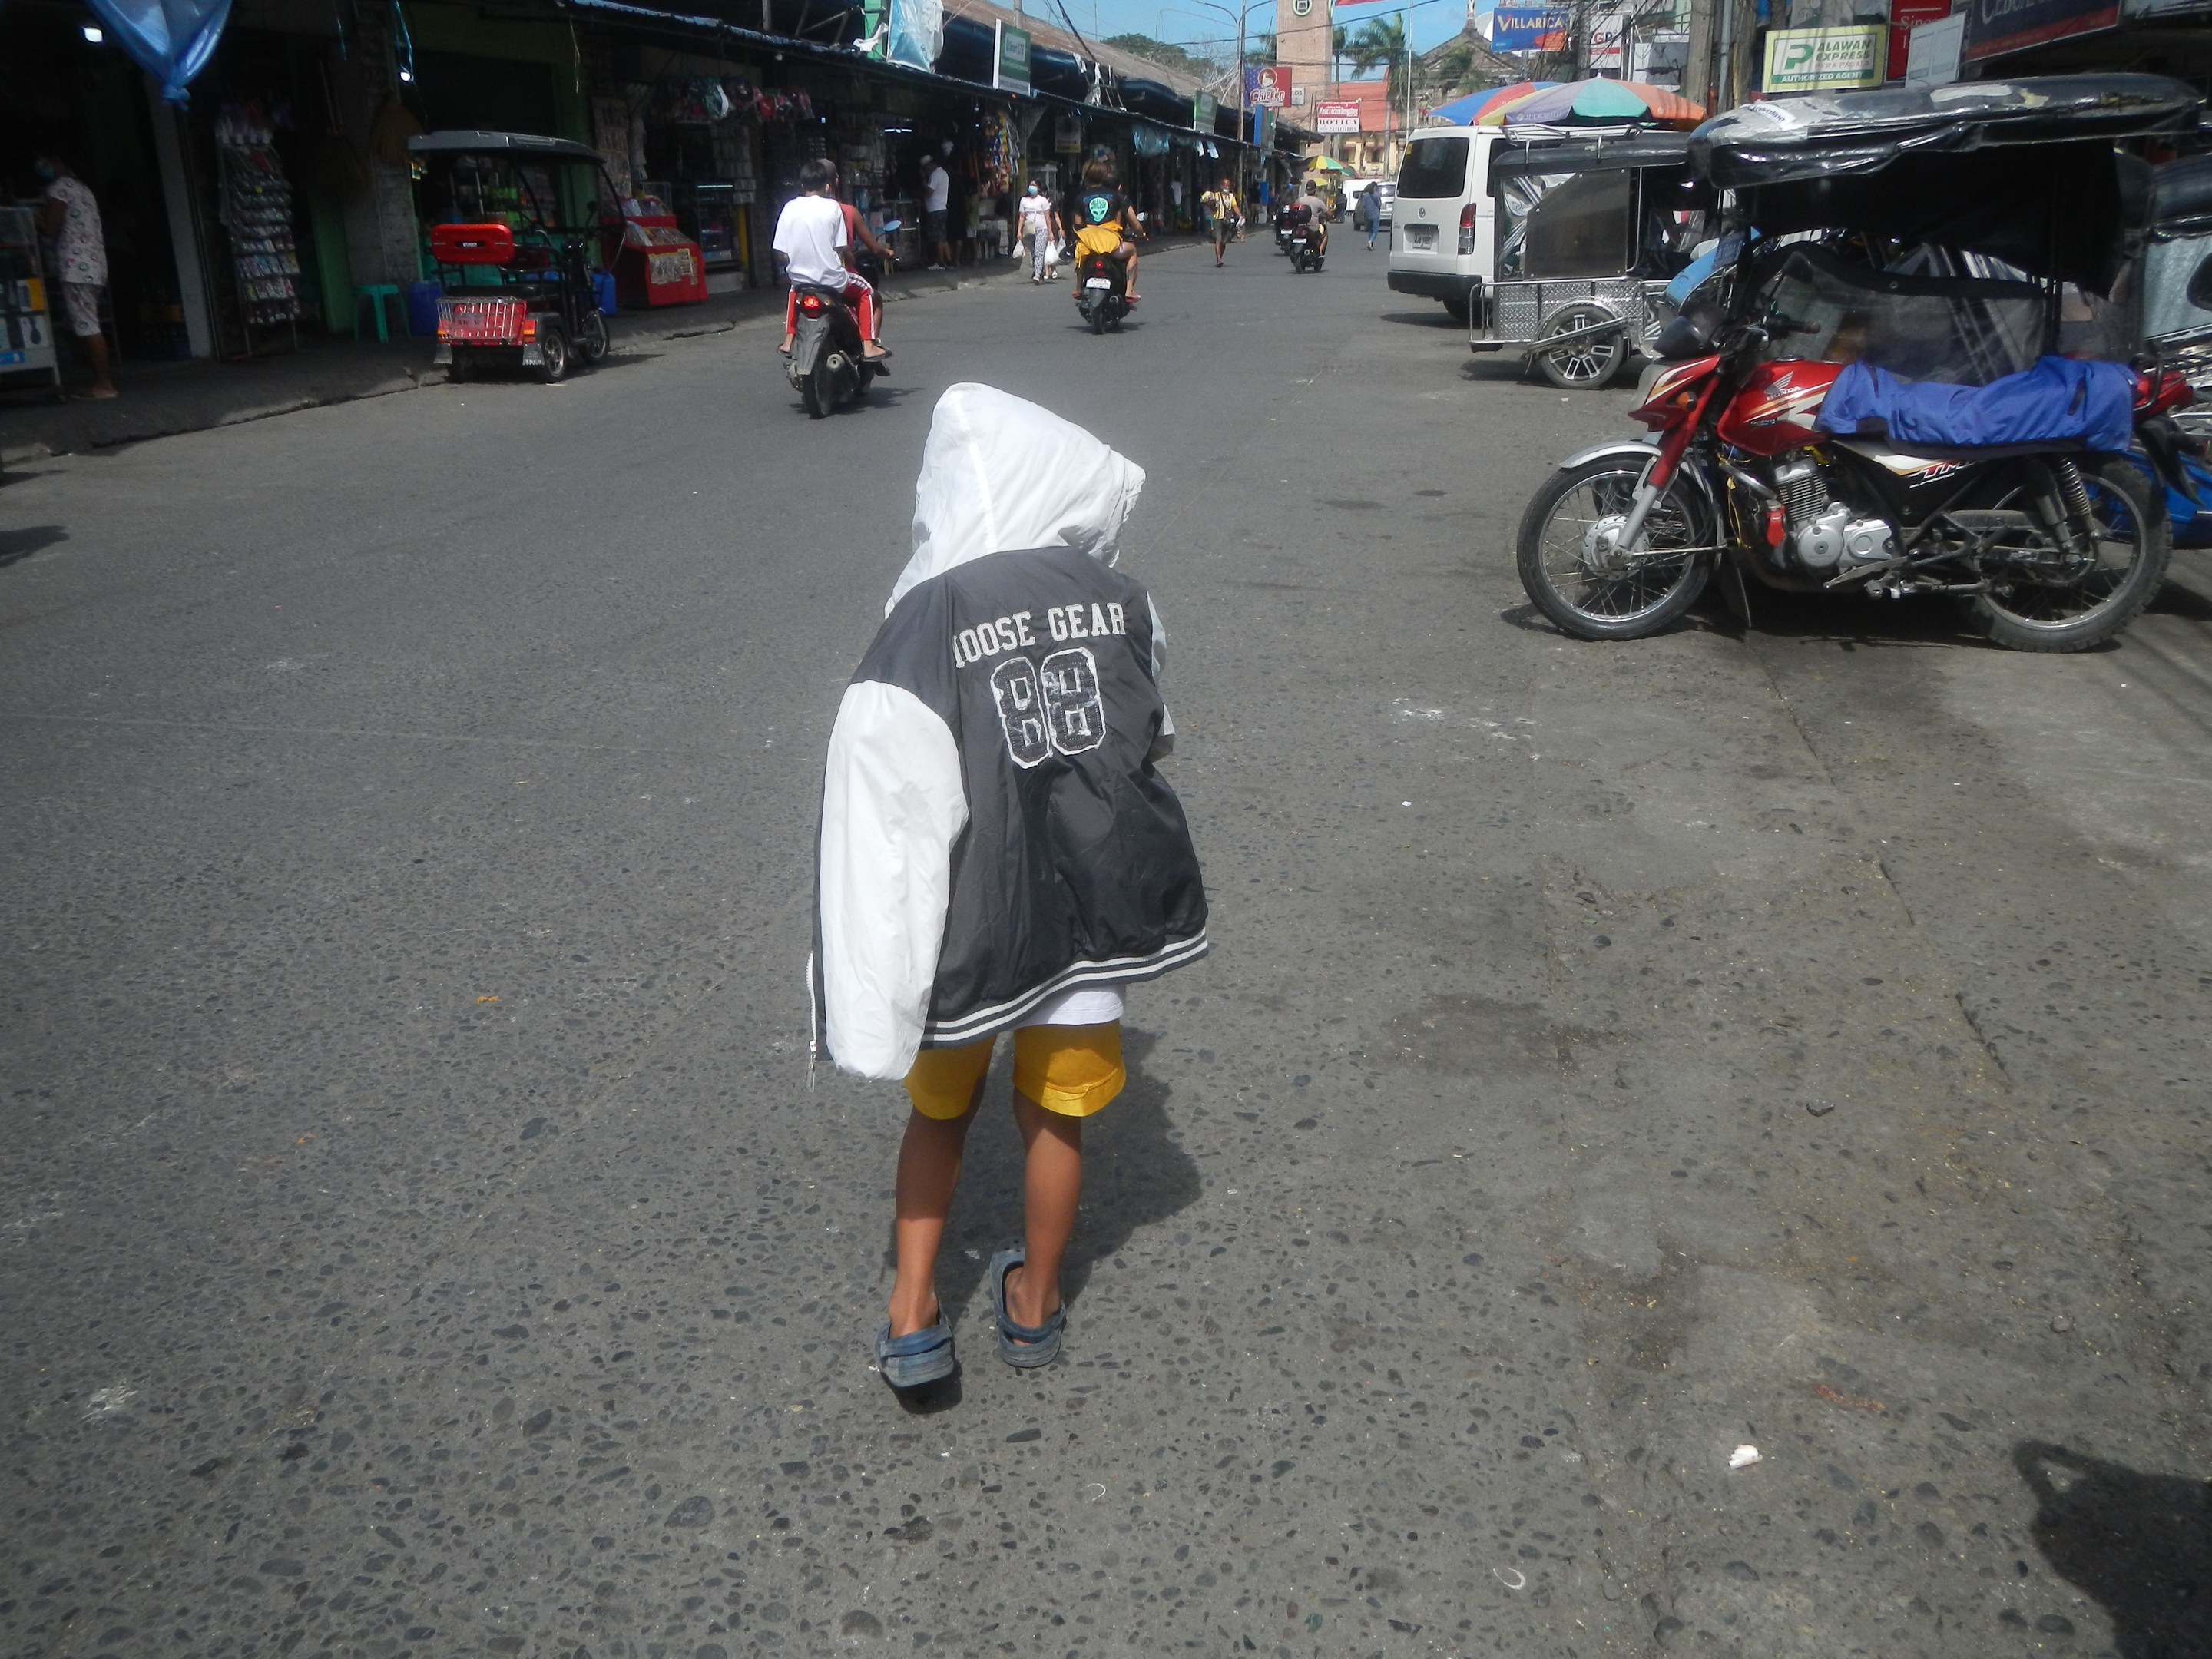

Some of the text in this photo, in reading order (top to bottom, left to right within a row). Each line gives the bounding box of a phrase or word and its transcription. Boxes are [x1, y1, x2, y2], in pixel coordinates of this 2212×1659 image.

[1497, 15, 1564, 32] VILLARICA
[1816, 50, 1870, 61] EXPRESS
[1781, 73, 1833, 83] AUTHORIZED
[1250, 88, 1286, 103] Chicken
[1767, 386, 1803, 402] HONDA
[1047, 602, 1127, 641] GEAR
